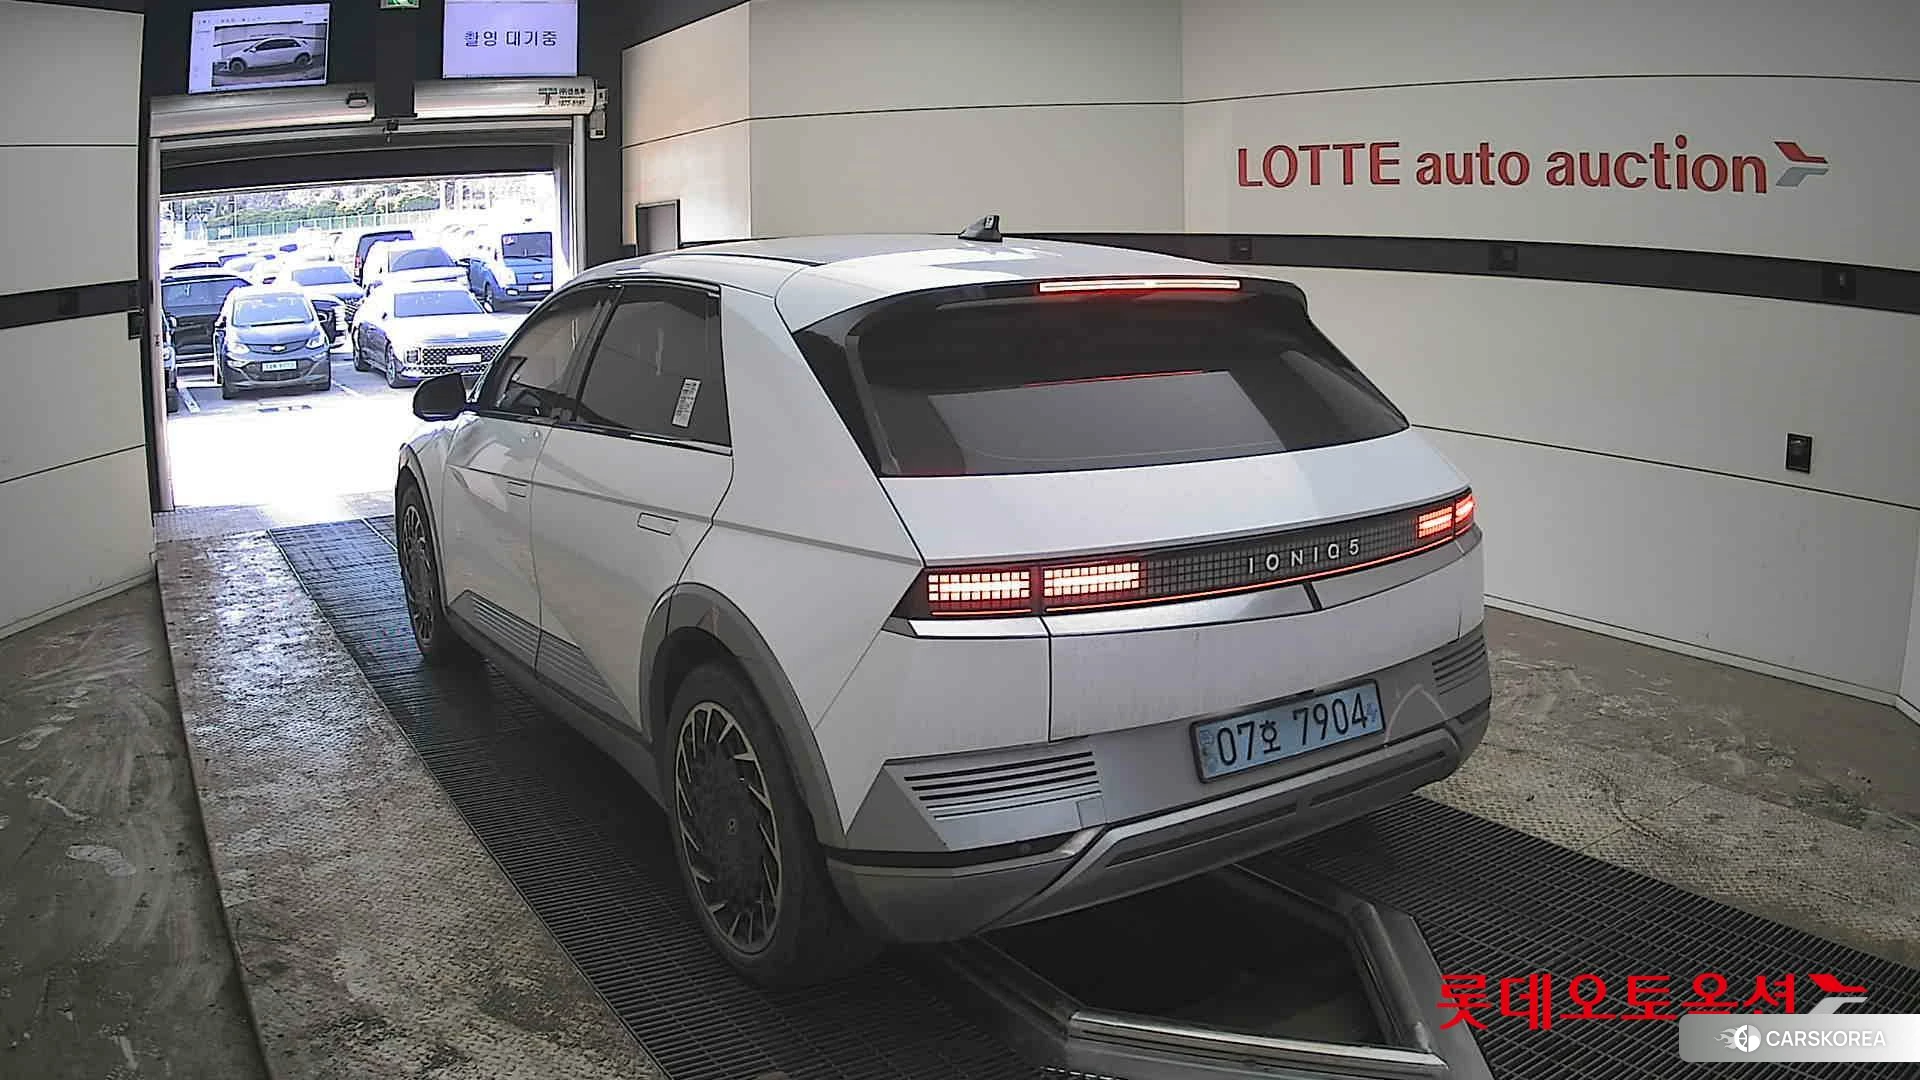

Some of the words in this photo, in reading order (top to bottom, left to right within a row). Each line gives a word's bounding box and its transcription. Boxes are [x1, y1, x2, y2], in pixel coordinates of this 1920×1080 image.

[506, 30, 558, 47] 대기중
[1237, 141, 1401, 189] LOTTE
[1415, 142, 1531, 187] auto
[1546, 134, 1768, 194] auction
[1216, 719, 1281, 766] 07호
[1292, 692, 1368, 746] 7904
